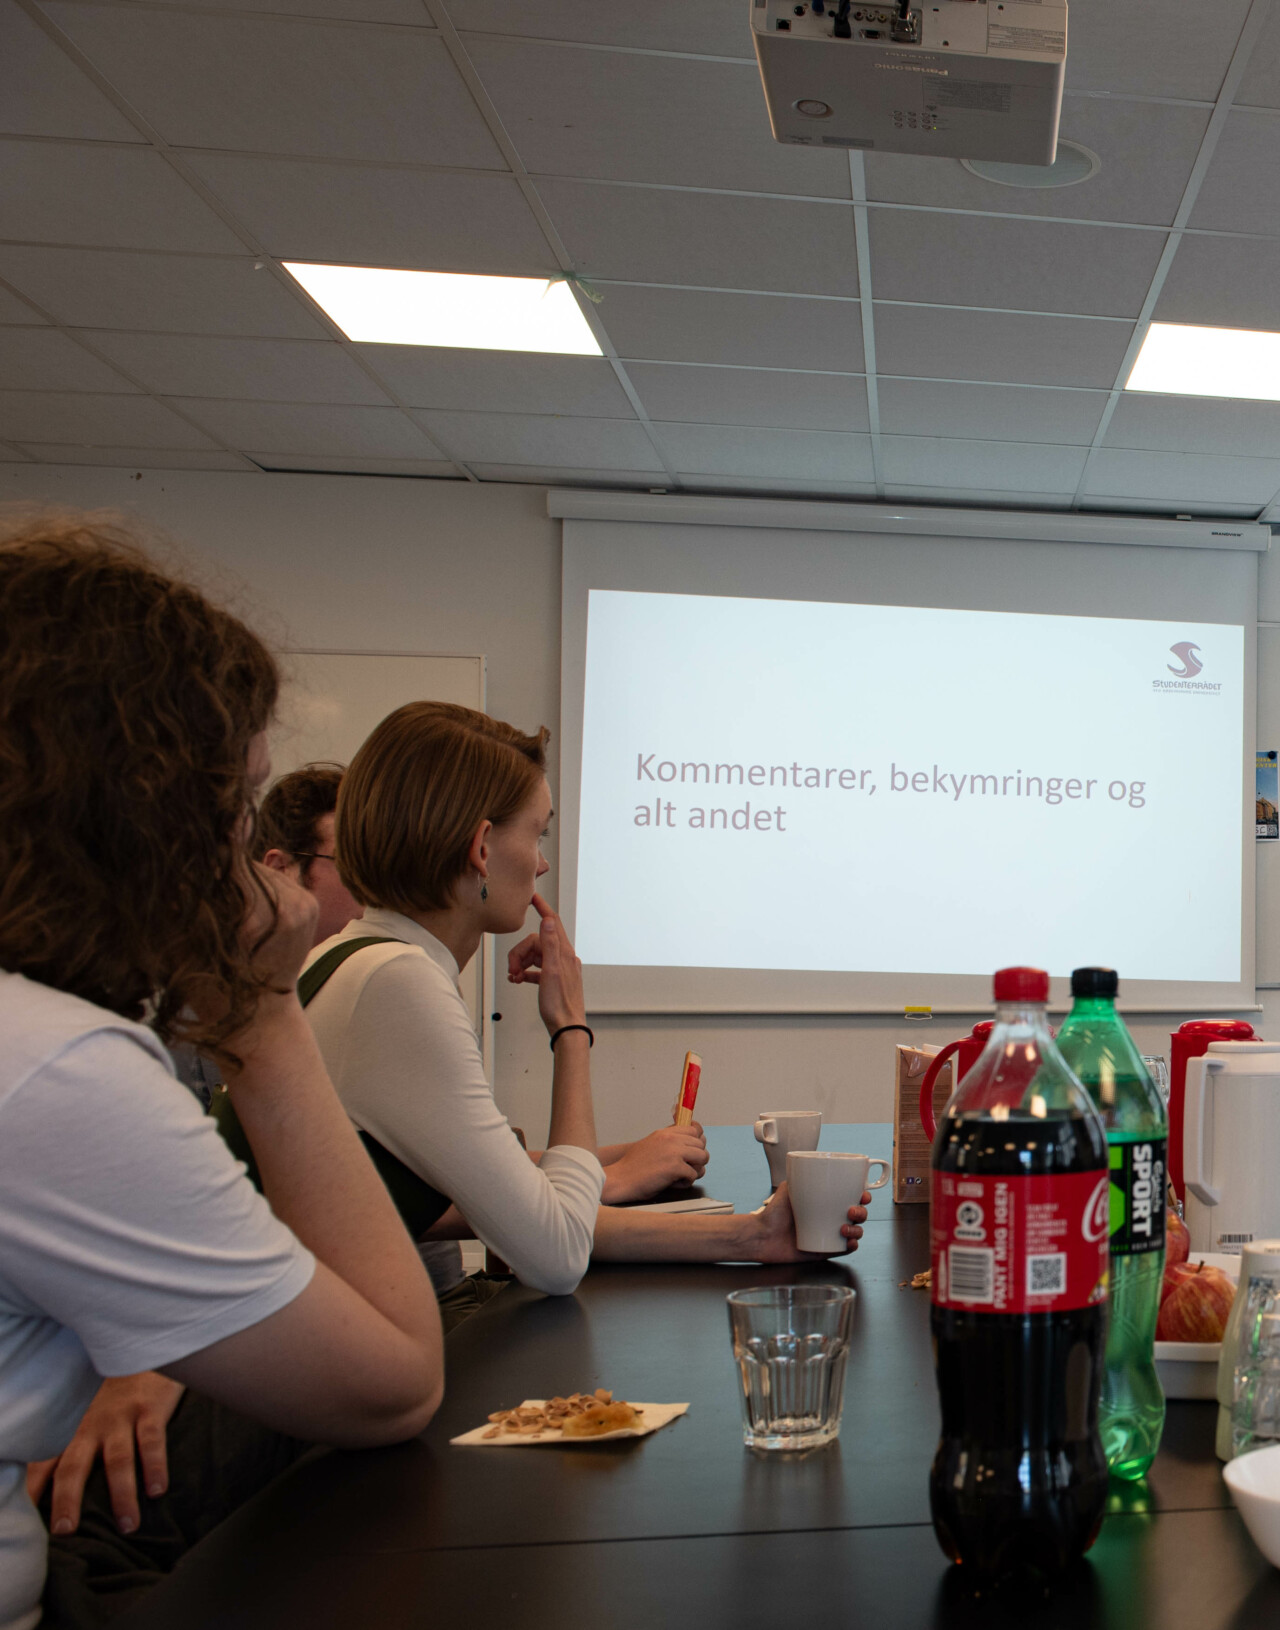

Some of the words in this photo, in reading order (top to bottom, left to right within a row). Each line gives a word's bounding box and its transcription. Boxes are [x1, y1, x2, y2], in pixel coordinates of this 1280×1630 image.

[636, 753, 877, 795] Kommentarer,
[890, 763, 1098, 805] bekymringer
[1108, 780, 1147, 808] og
[633, 797, 676, 828] alt
[688, 801, 787, 832] andet
[1132, 1144, 1153, 1237] SPORT
